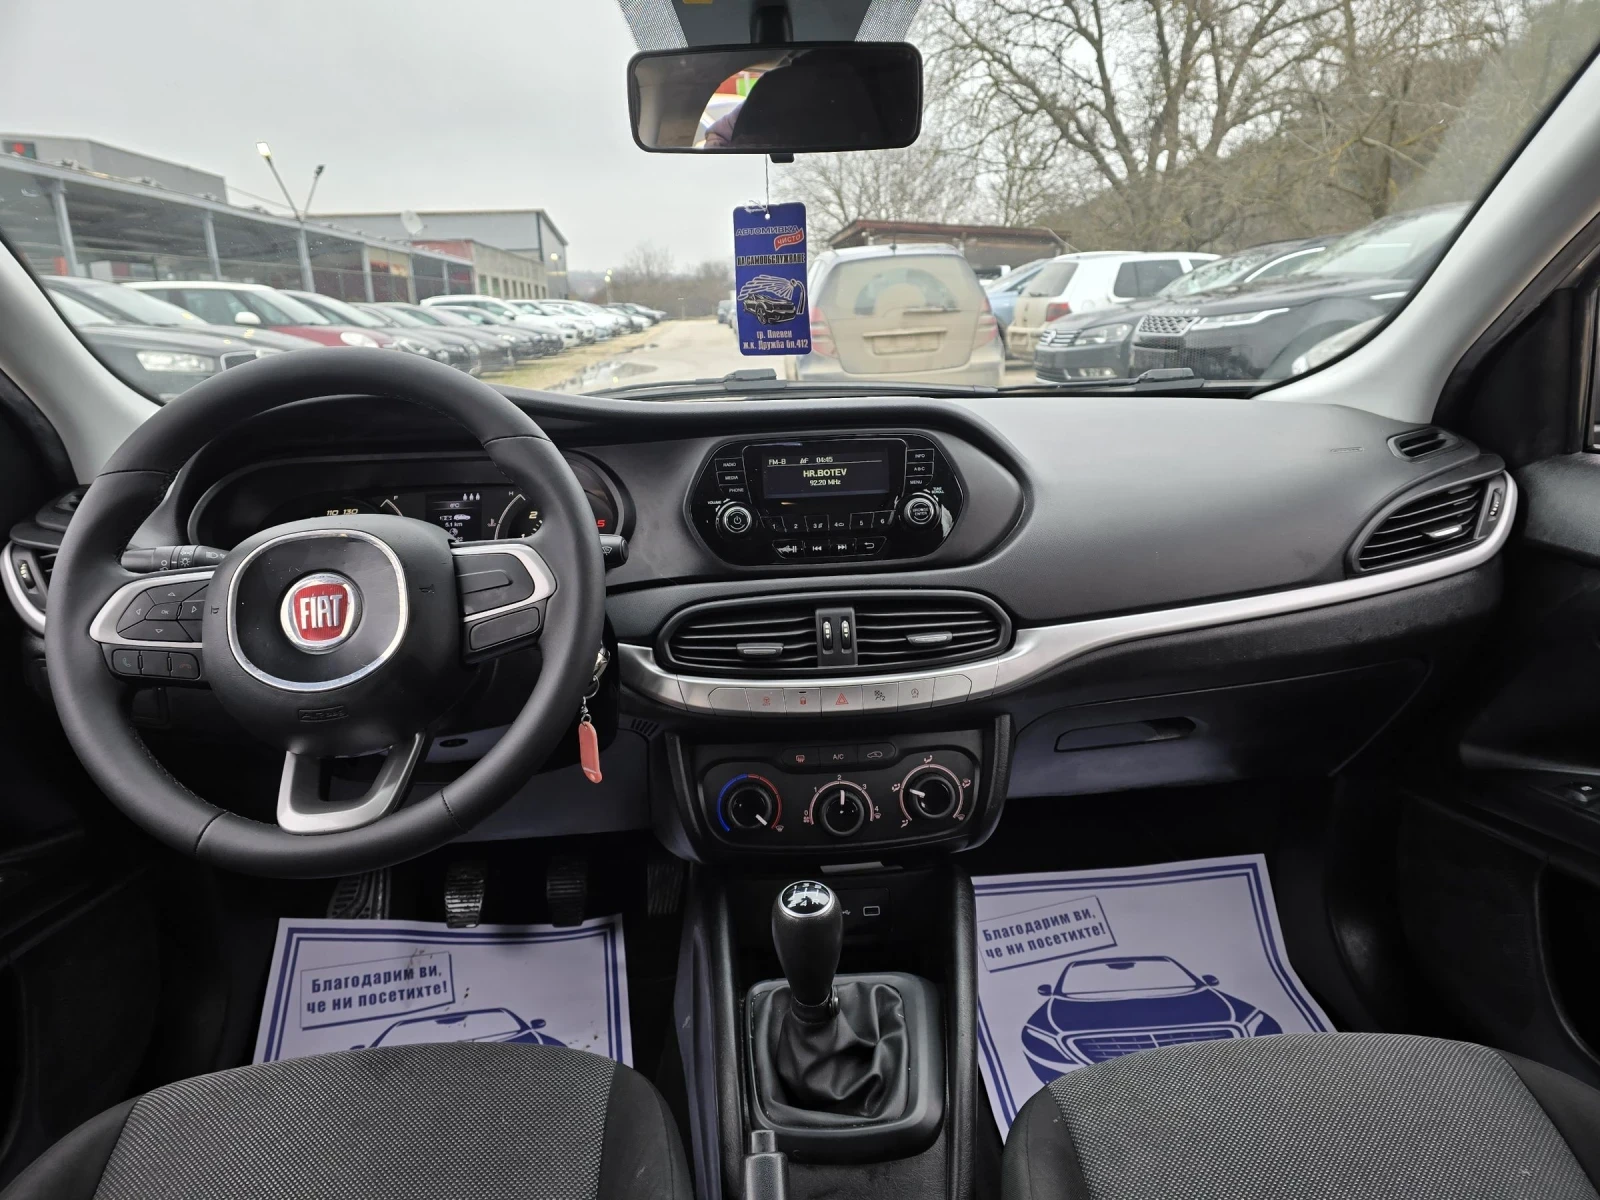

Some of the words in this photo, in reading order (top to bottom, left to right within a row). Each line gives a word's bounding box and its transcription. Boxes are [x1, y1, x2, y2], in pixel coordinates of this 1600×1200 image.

[735, 225, 799, 236] АВТОМИВКА
[777, 234, 801, 245] ЧИСТО
[757, 331, 766, 339] гр.
[767, 329, 793, 339] Плевен
[758, 340, 785, 350] Дружба
[803, 468, 847, 477] HR.BOTEV
[529, 511, 538, 519] 2
[300, 594, 343, 630] FIAT
[983, 913, 1071, 941] Благодарим
[1073, 908, 1096, 921] ви,
[985, 947, 1003, 959] че
[1006, 942, 1025, 955] ни
[1027, 922, 1106, 951] посетихте!
[312, 968, 414, 993] Благодарим
[419, 965, 442, 979] ви,
[307, 1001, 326, 1014] че
[332, 997, 352, 1011] ни
[358, 980, 447, 1007] посетихте!
